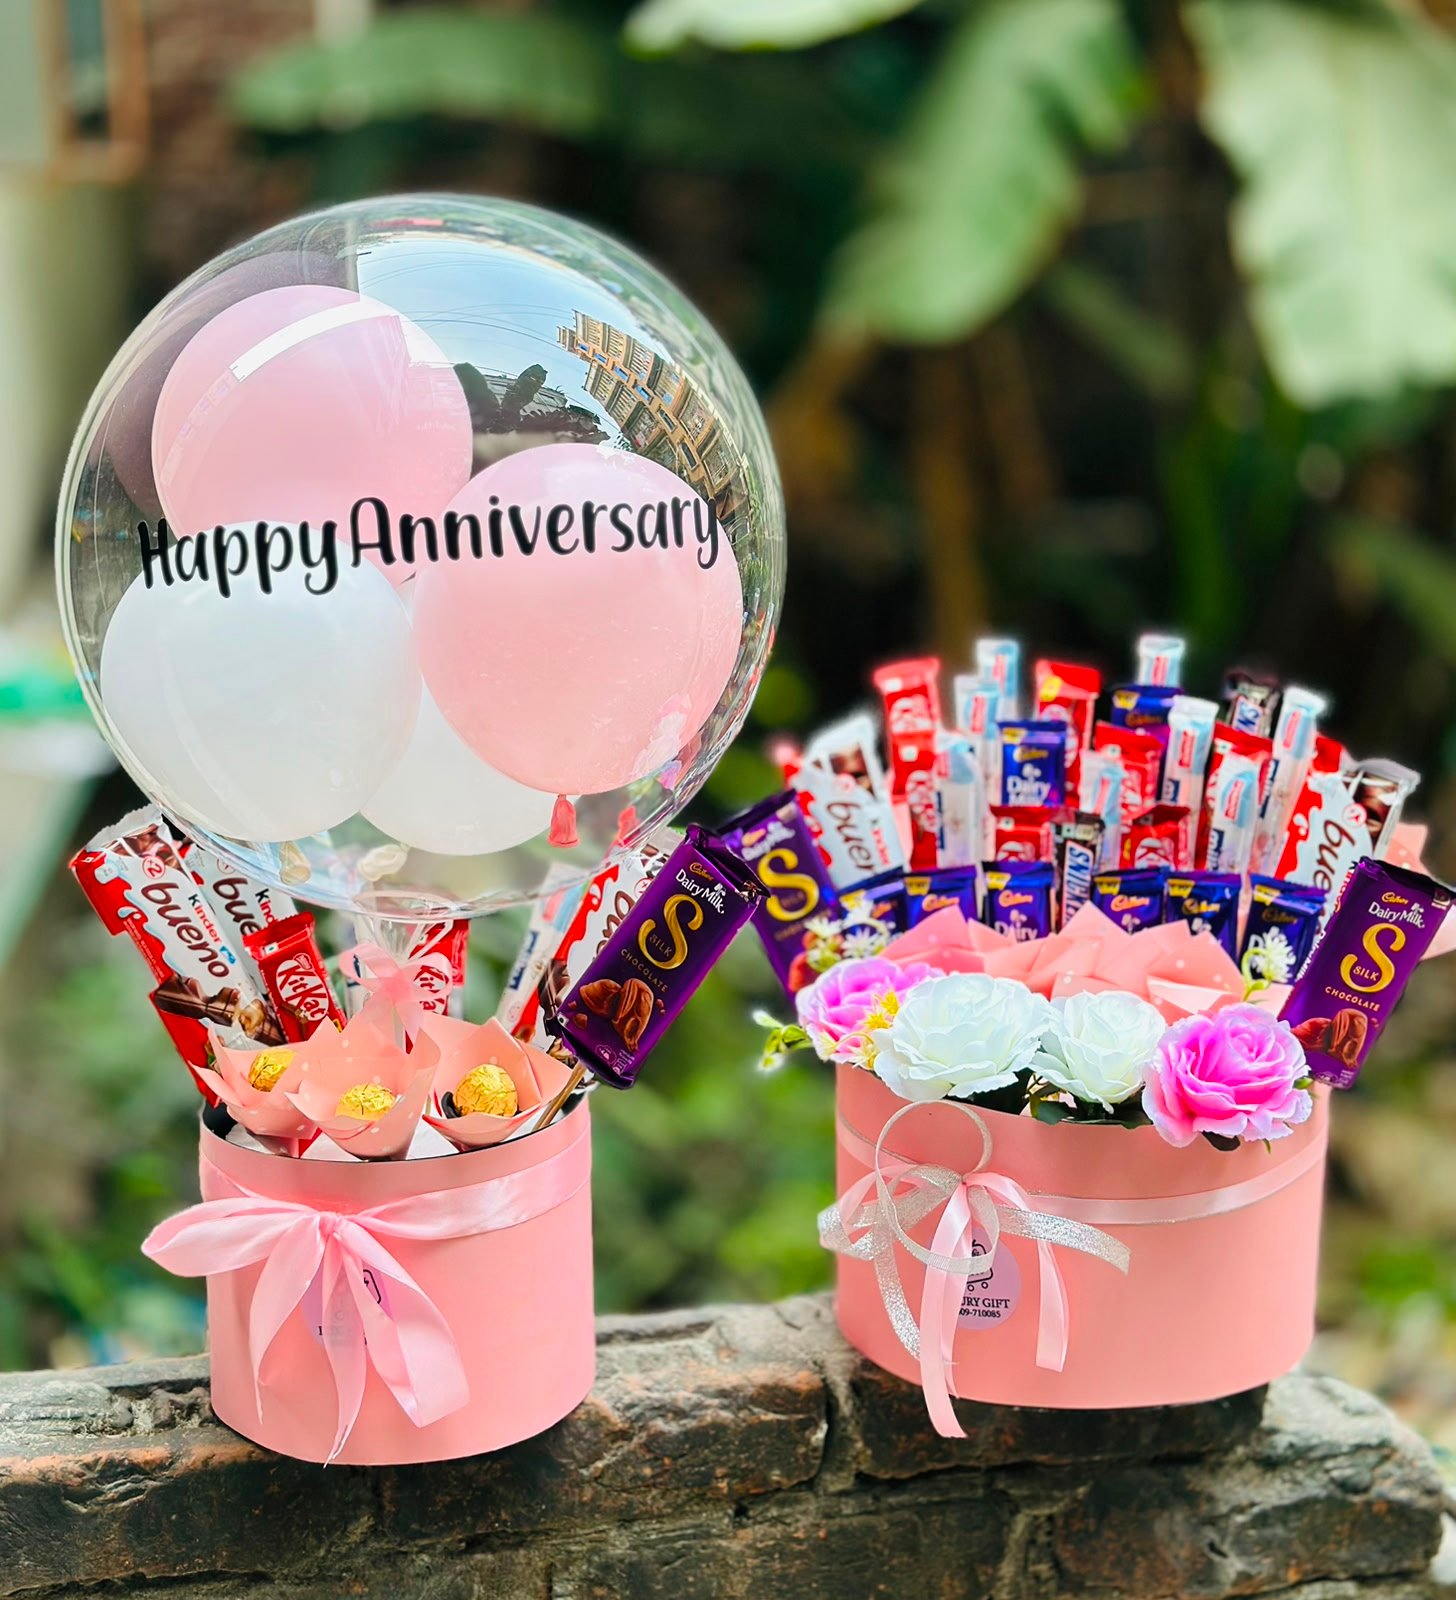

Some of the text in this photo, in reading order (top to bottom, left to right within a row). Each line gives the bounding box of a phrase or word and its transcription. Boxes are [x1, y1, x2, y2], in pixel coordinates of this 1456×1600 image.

[137, 495, 719, 598] Happy Anniversary
[141, 882, 229, 978] bueno
[649, 933, 673, 957] SILK
[620, 948, 669, 993] CHOCOLATE
[1352, 965, 1380, 982] SILK
[278, 968, 327, 1019] KitKat
[1325, 986, 1381, 1012] CHOCOLATE
[982, 1298, 1010, 1309] GIFT
